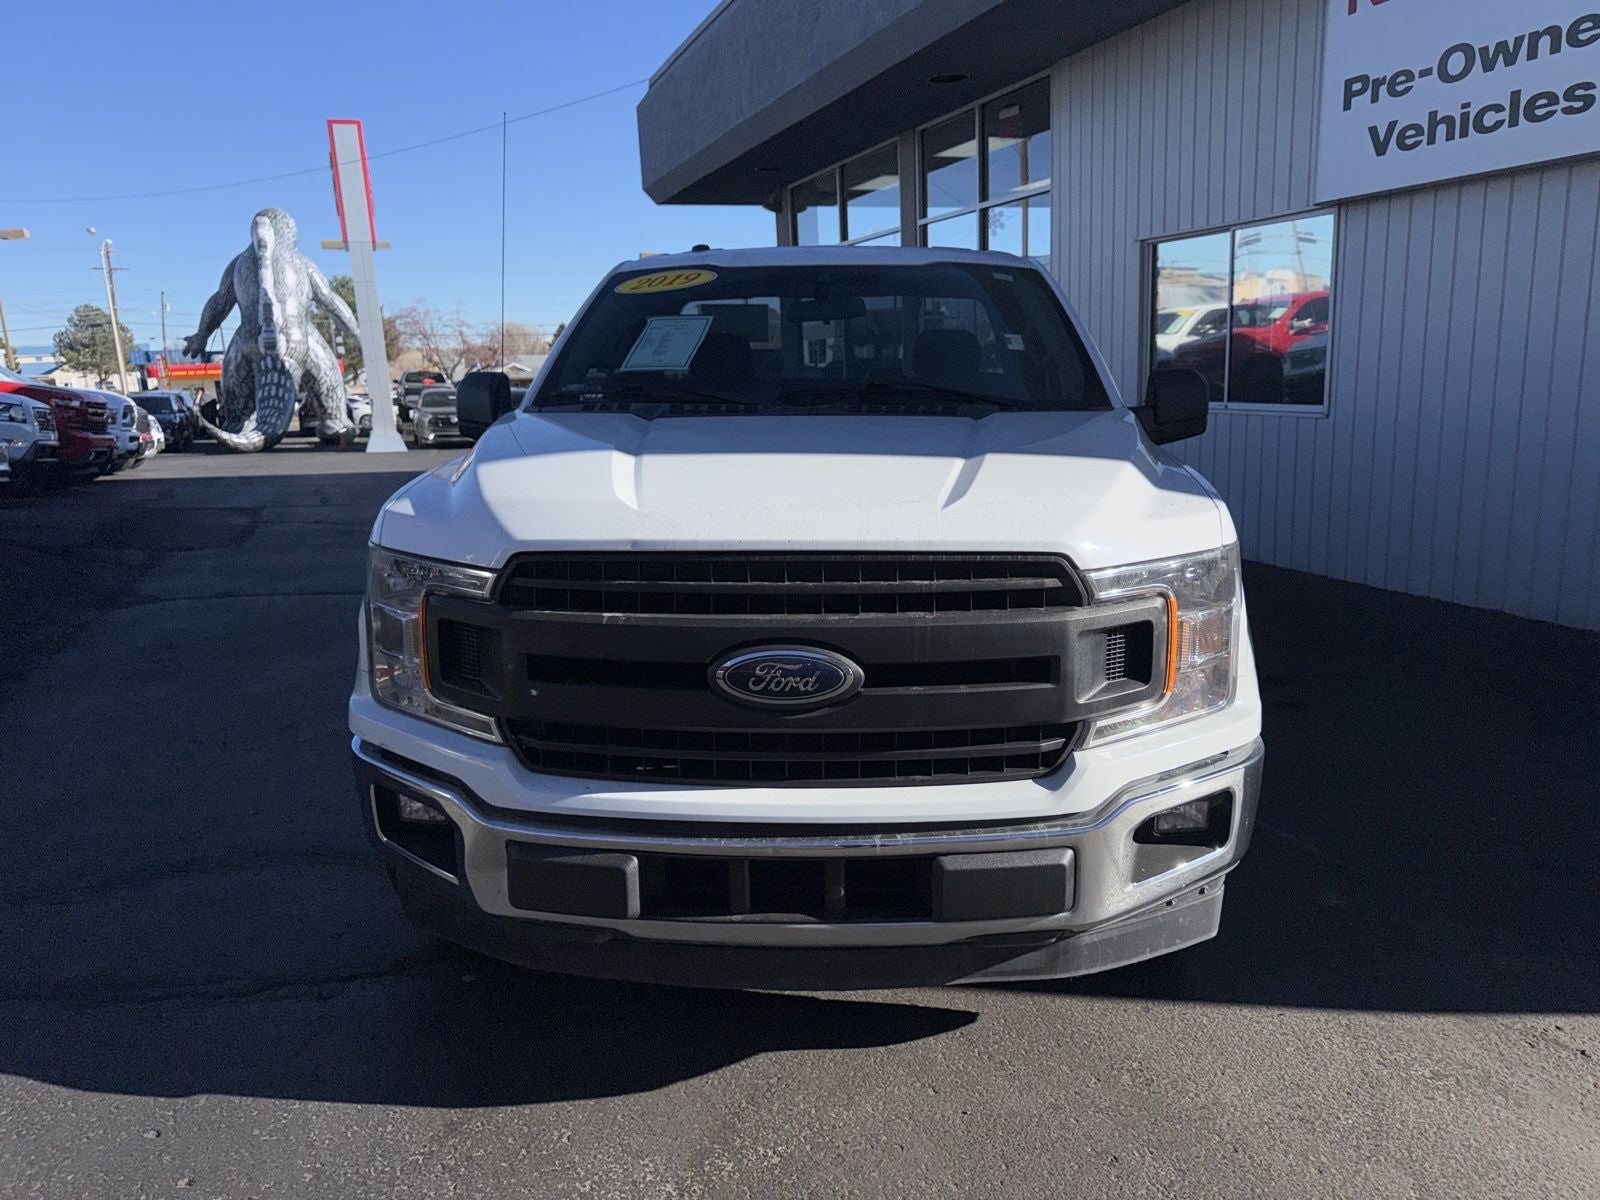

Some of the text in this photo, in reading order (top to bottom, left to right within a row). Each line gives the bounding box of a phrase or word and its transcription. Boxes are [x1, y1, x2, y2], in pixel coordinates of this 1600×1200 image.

[1367, 81, 1597, 157] Vehicles
[629, 271, 702, 291] 2019
[748, 662, 820, 692] Ford
